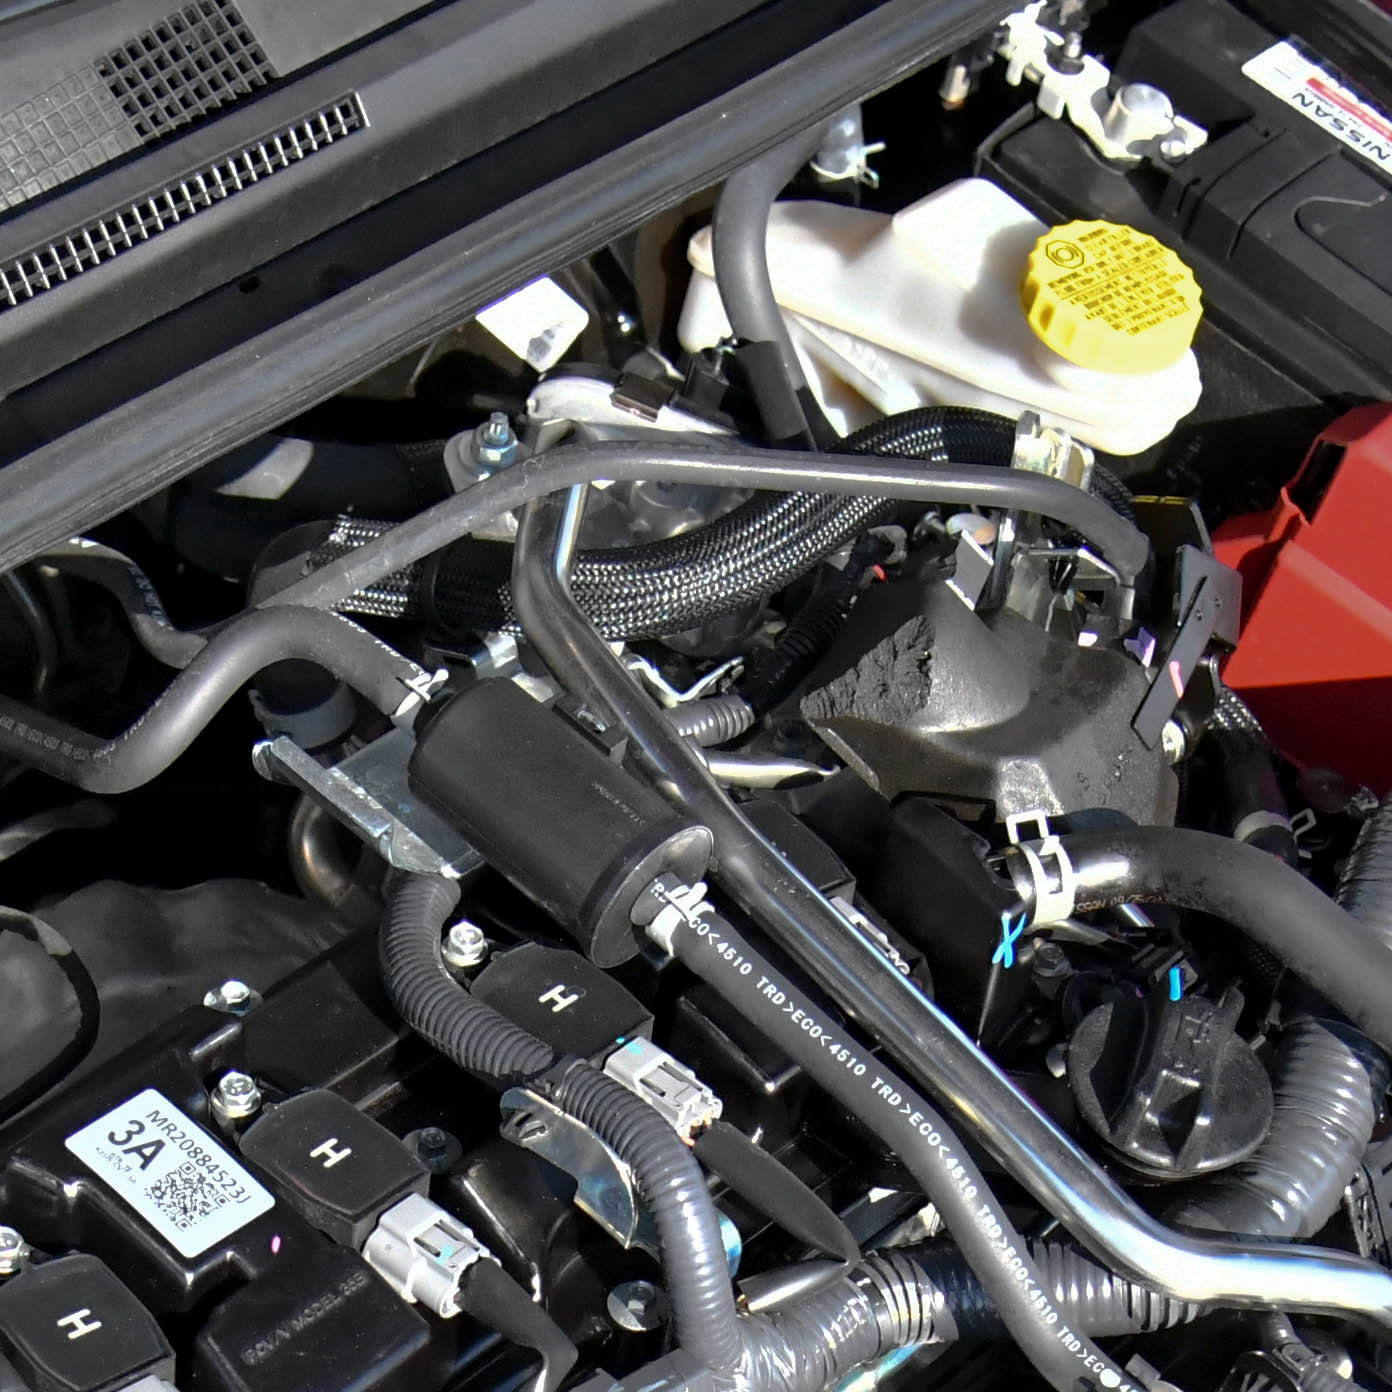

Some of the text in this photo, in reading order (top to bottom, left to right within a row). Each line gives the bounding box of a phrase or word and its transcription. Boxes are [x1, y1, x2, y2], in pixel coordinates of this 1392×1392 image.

[1292, 92, 1391, 161] NISSAN
[539, 984, 579, 1013] H
[107, 1119, 166, 1171] 3A
[145, 1109, 252, 1205] MR20884523J
[310, 1137, 352, 1169] H
[57, 1307, 102, 1341] H
